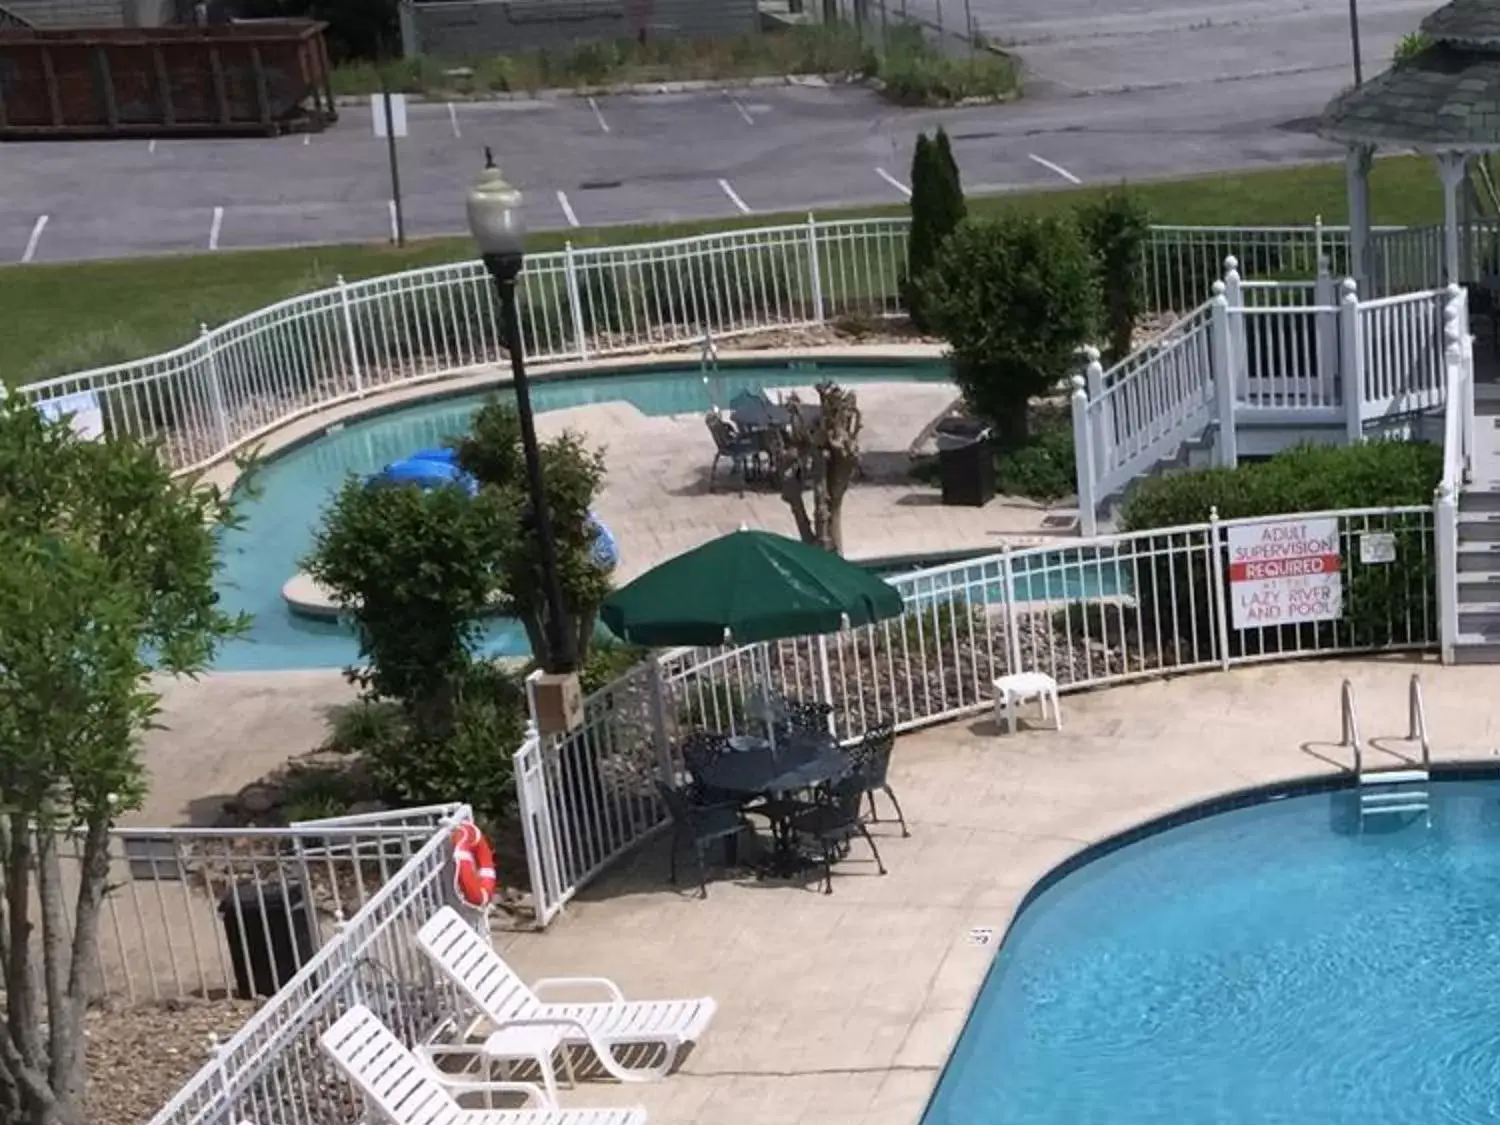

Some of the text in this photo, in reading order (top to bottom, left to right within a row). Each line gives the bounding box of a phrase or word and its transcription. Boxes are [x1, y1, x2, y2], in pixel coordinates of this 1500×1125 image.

[1262, 526, 1307, 542] ADULT
[1236, 538, 1333, 562] SUPERVISION
[1245, 558, 1325, 578] REQUIRED
[1241, 586, 1331, 607] LAZY RIVER
[1248, 602, 1332, 620] AND POOL
